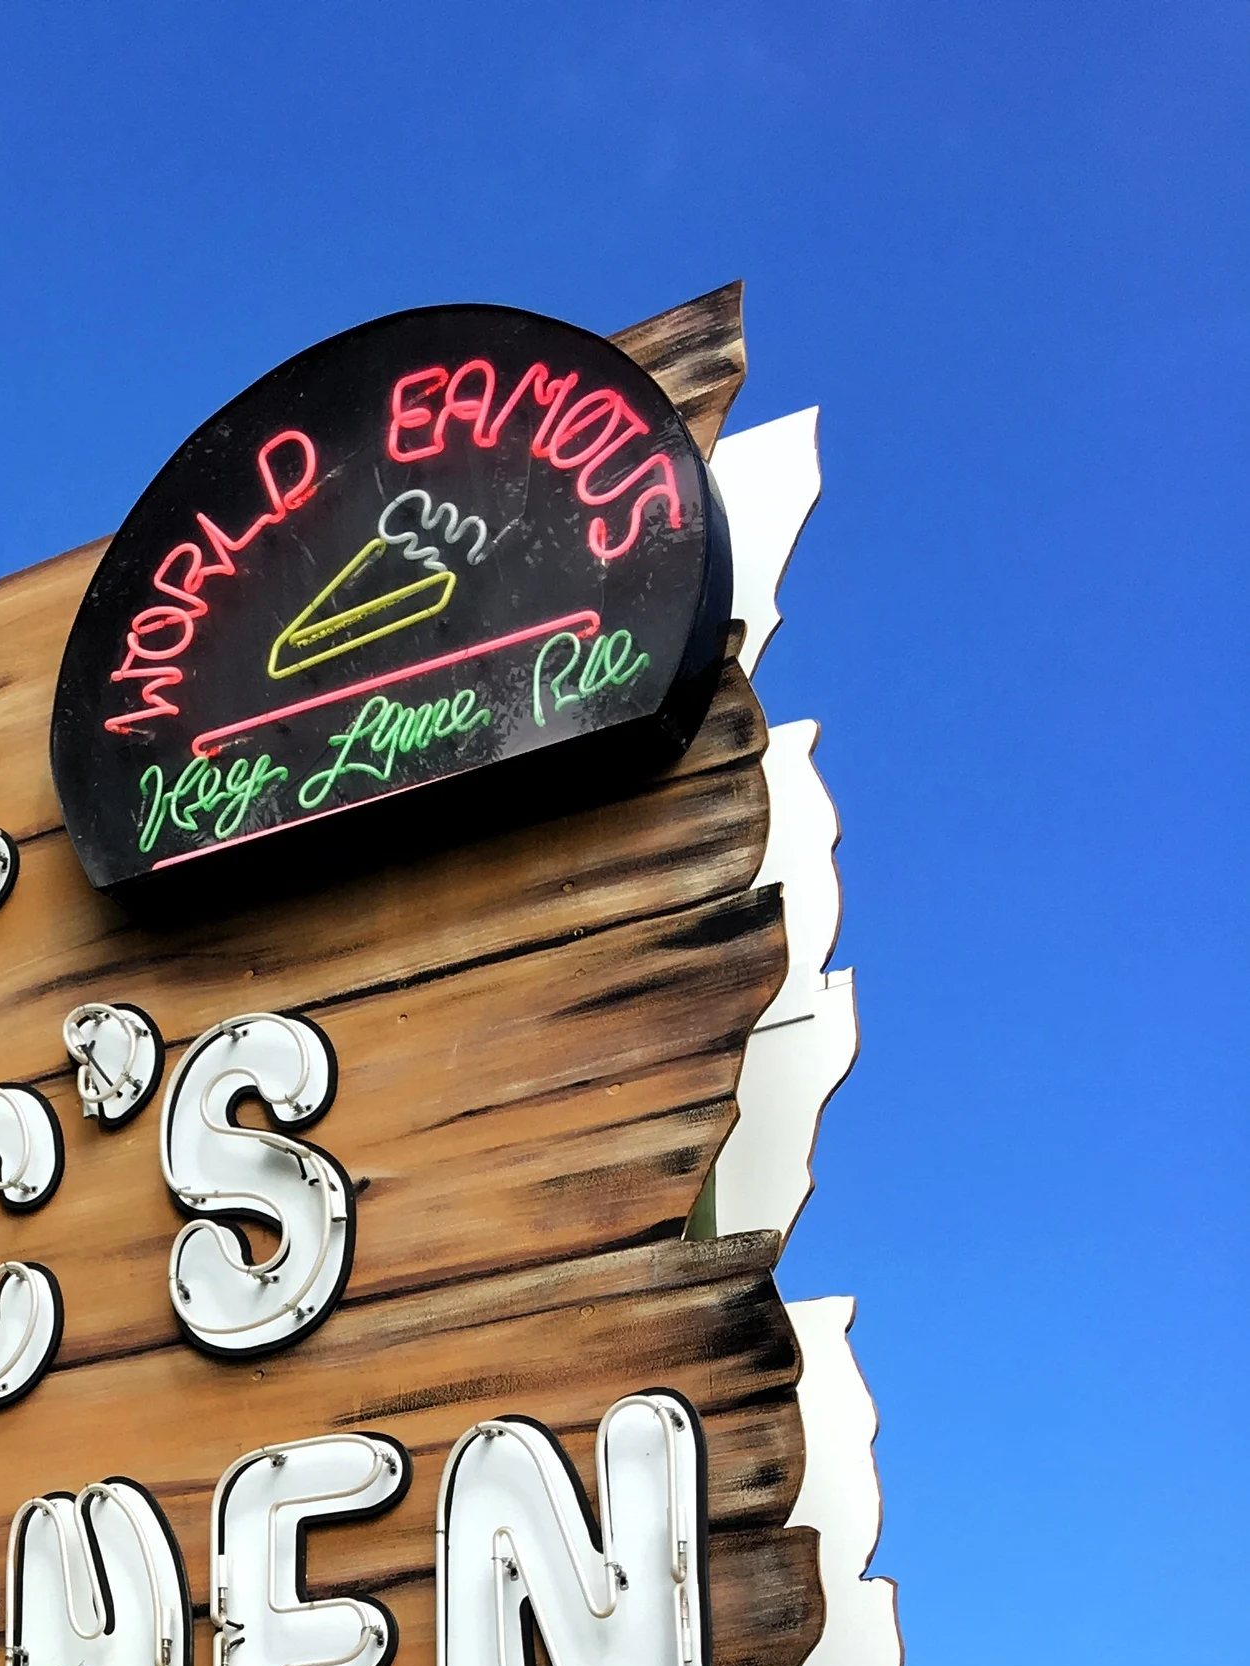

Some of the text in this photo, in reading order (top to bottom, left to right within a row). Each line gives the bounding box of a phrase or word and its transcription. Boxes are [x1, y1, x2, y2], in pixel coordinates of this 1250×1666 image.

[105, 430, 317, 734] WORLD
[139, 754, 288, 852] Key
[533, 629, 650, 727] Pie
